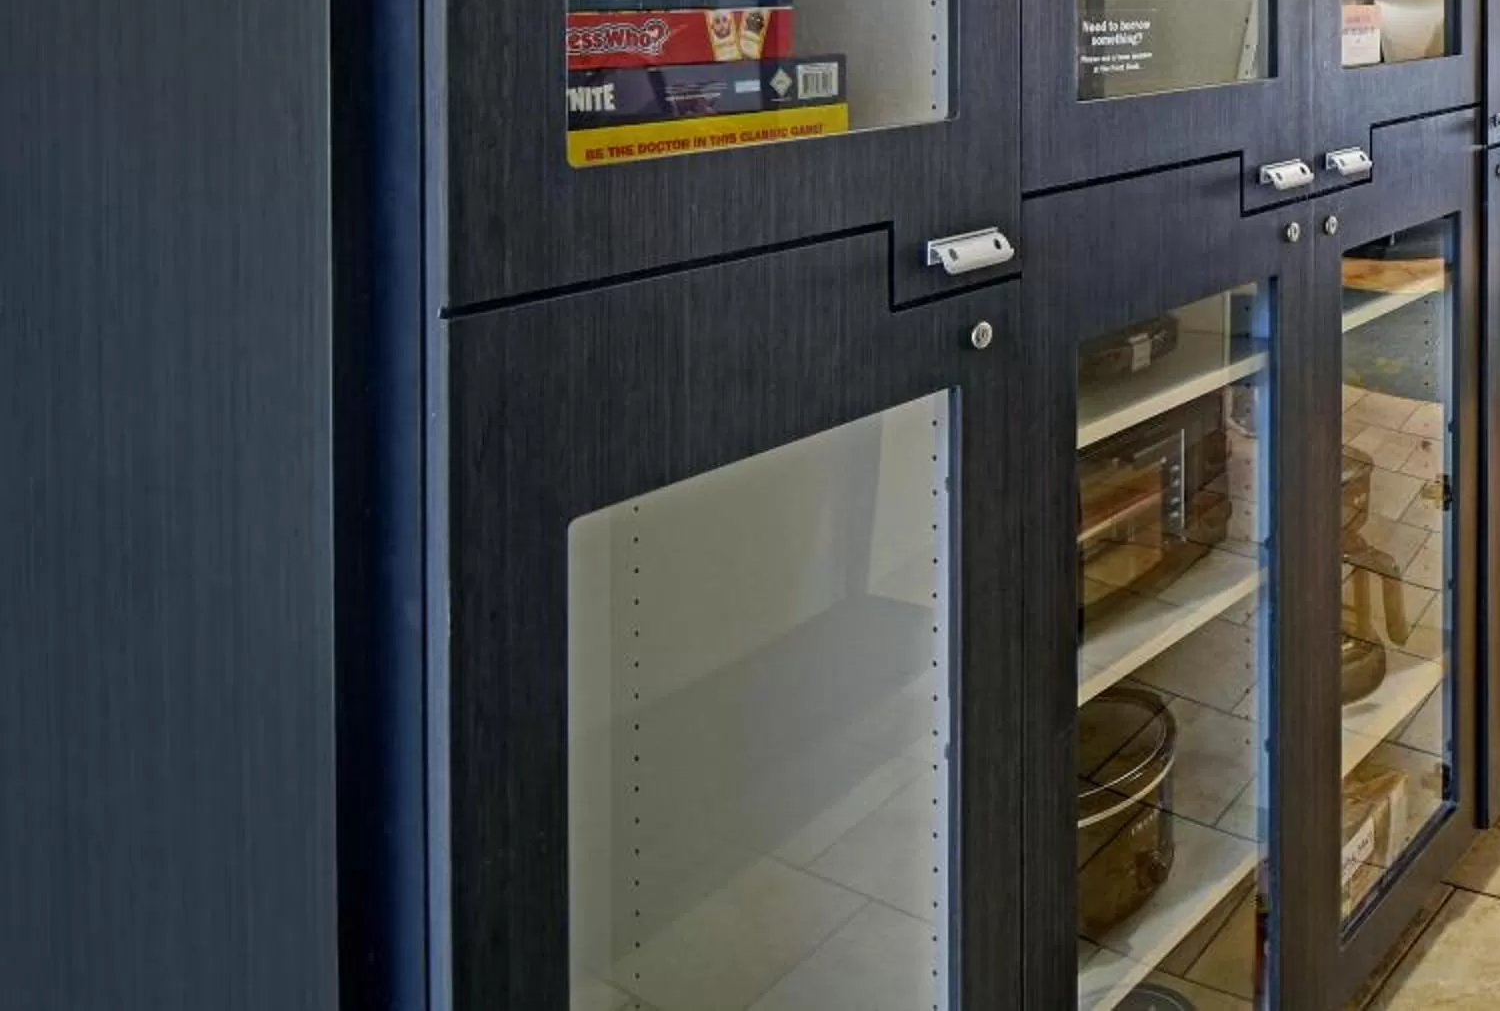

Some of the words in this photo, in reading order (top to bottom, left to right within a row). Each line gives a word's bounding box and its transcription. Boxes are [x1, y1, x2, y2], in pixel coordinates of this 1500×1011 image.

[1082, 20, 1107, 32] Need
[567, 82, 616, 111] NITE
[585, 147, 604, 161] BE
[607, 144, 635, 158] THE
[638, 138, 690, 155] DOCTOR
[693, 136, 707, 148] IN
[710, 132, 737, 146] THIS
[740, 127, 788, 143] CLASSIC
[791, 123, 823, 137] GAME!
